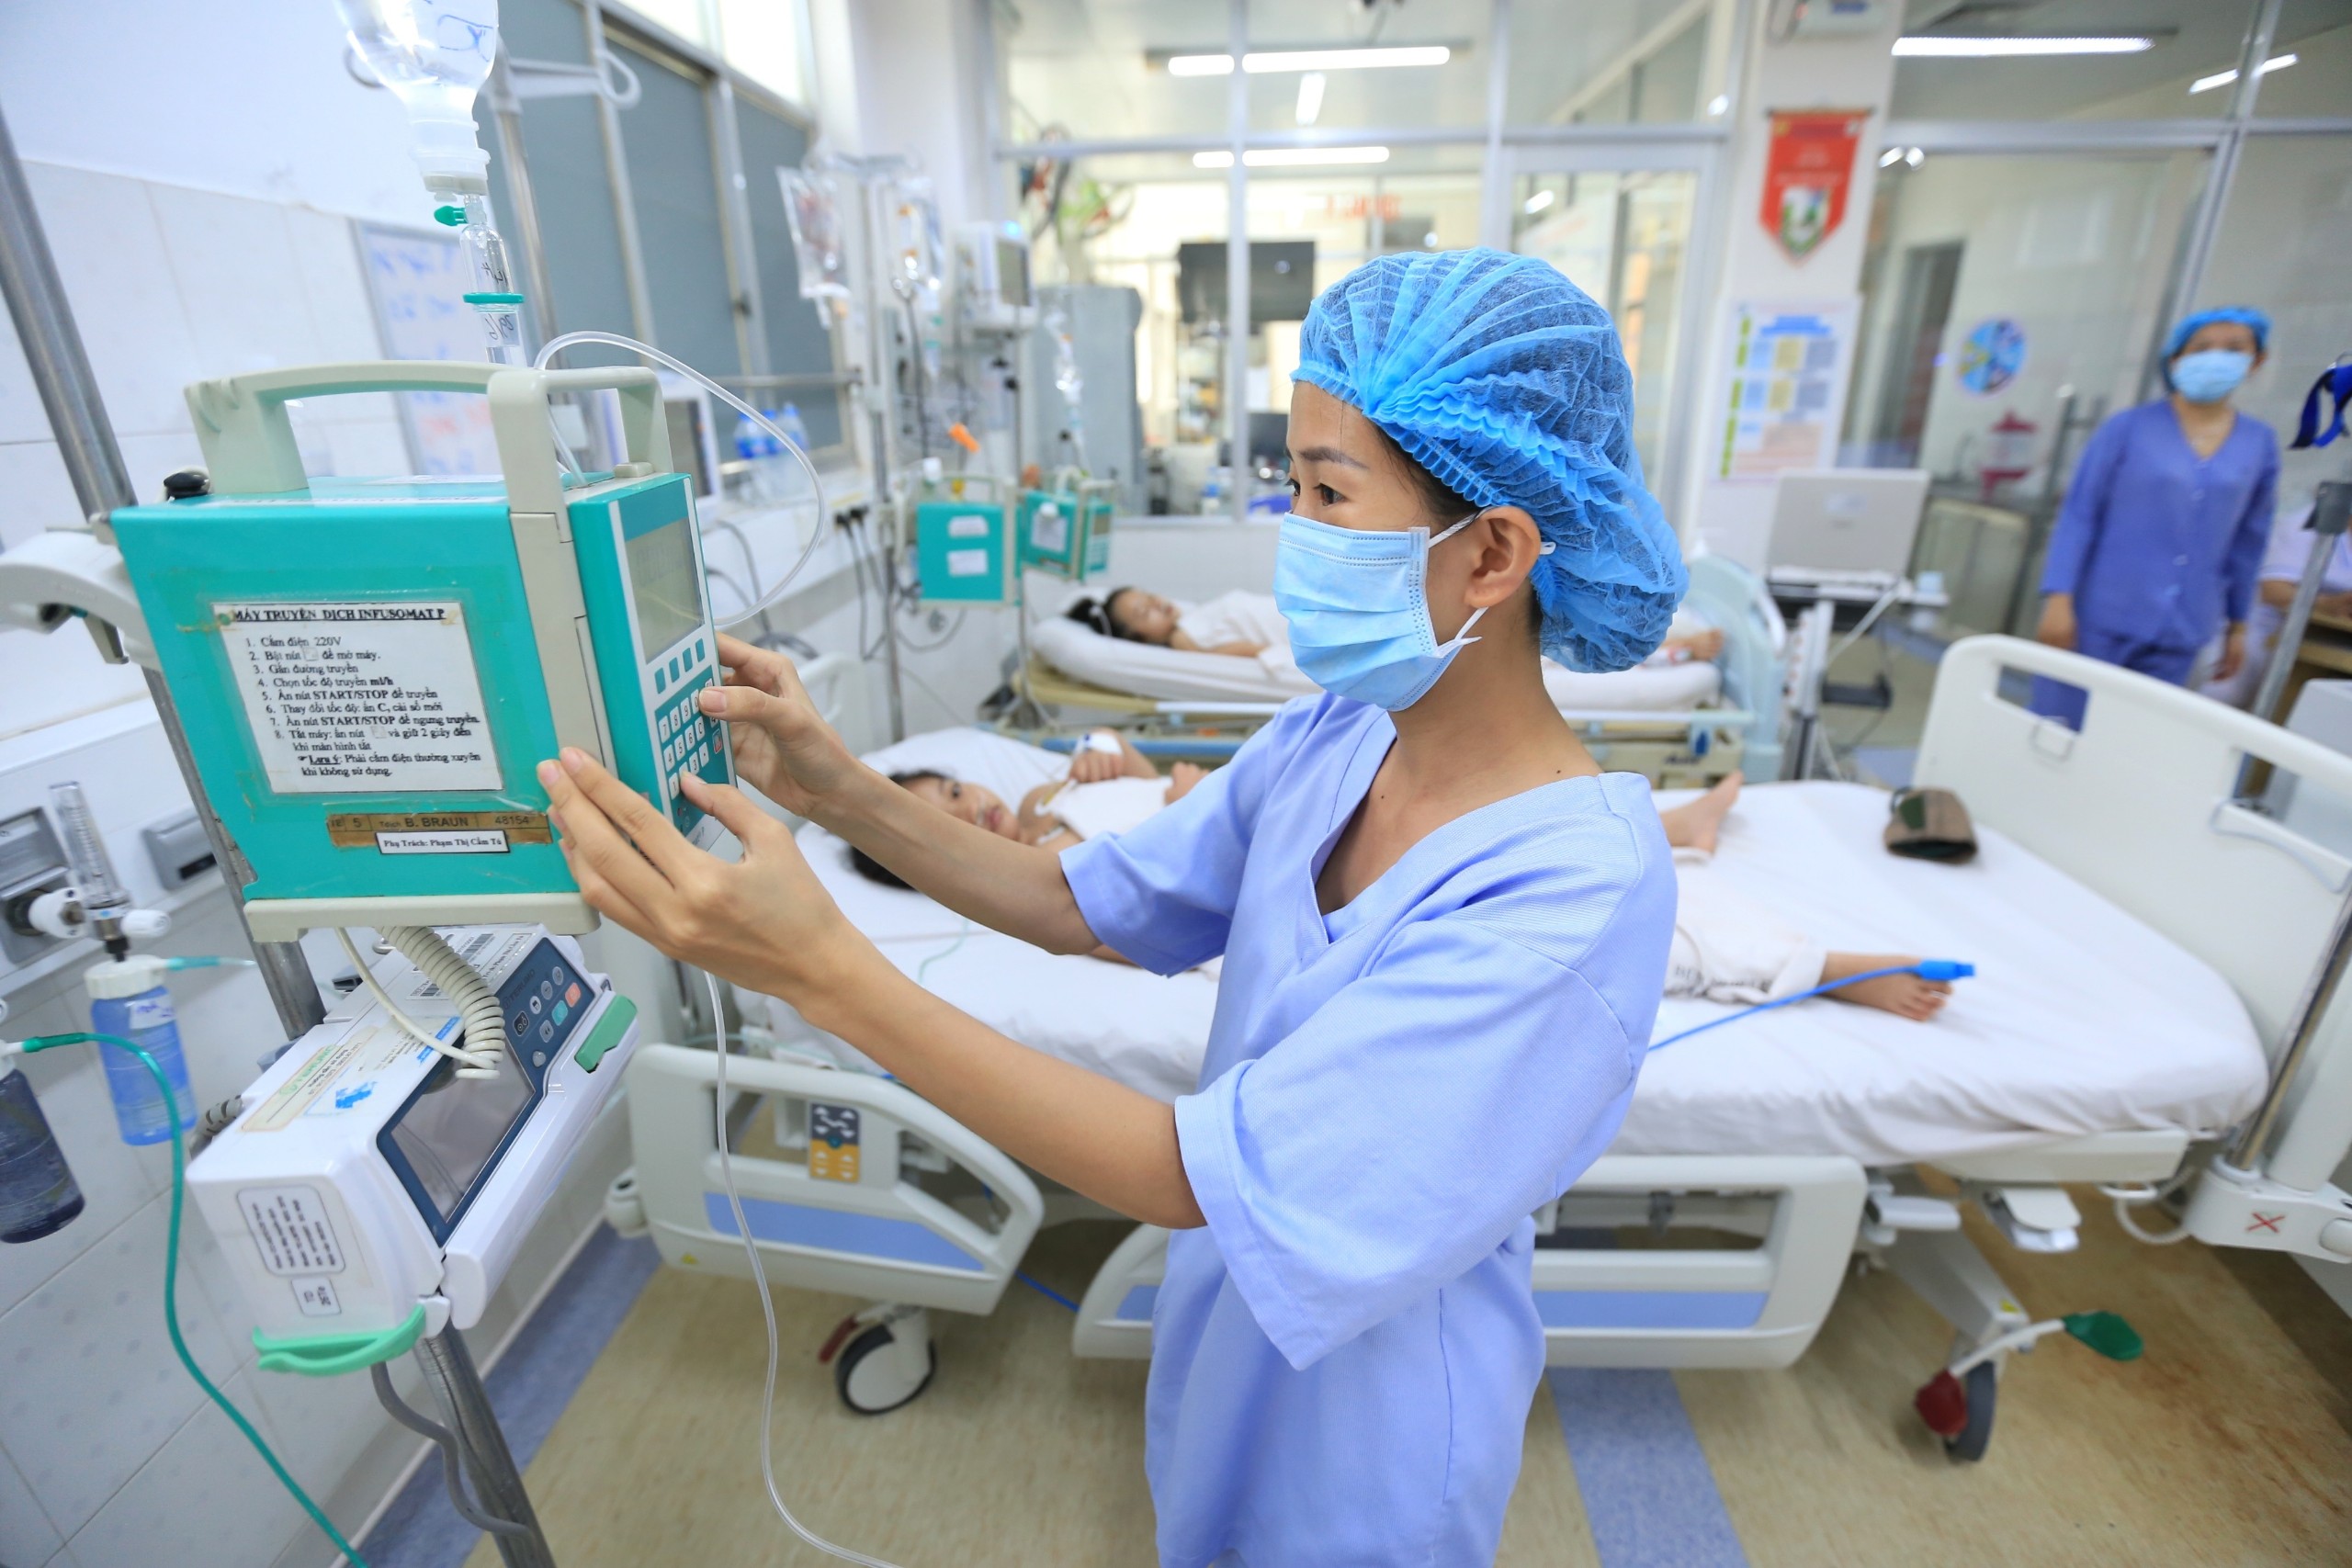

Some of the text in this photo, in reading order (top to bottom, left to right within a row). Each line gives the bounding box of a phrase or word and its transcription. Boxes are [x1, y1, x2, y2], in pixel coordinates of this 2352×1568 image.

[322, 609, 355, 620] DỊCH
[358, 609, 433, 619] INFUSOMAT
[437, 608, 446, 618] P
[288, 637, 310, 648] điện
[313, 637, 342, 646] 220V
[253, 664, 264, 674] 3.
[258, 678, 268, 687] 4.
[274, 678, 300, 688] Chọn
[370, 677, 393, 686] ml/h
[262, 692, 272, 700] 5.
[312, 690, 389, 699] START/STOP
[266, 705, 276, 714] 6.
[280, 705, 306, 715] Thay
[321, 716, 395, 725] START/STOP
[421, 728, 428, 737] 2
[292, 742, 309, 751] khi
[404, 818, 418, 828] B.
[421, 817, 469, 827] BRAUN
